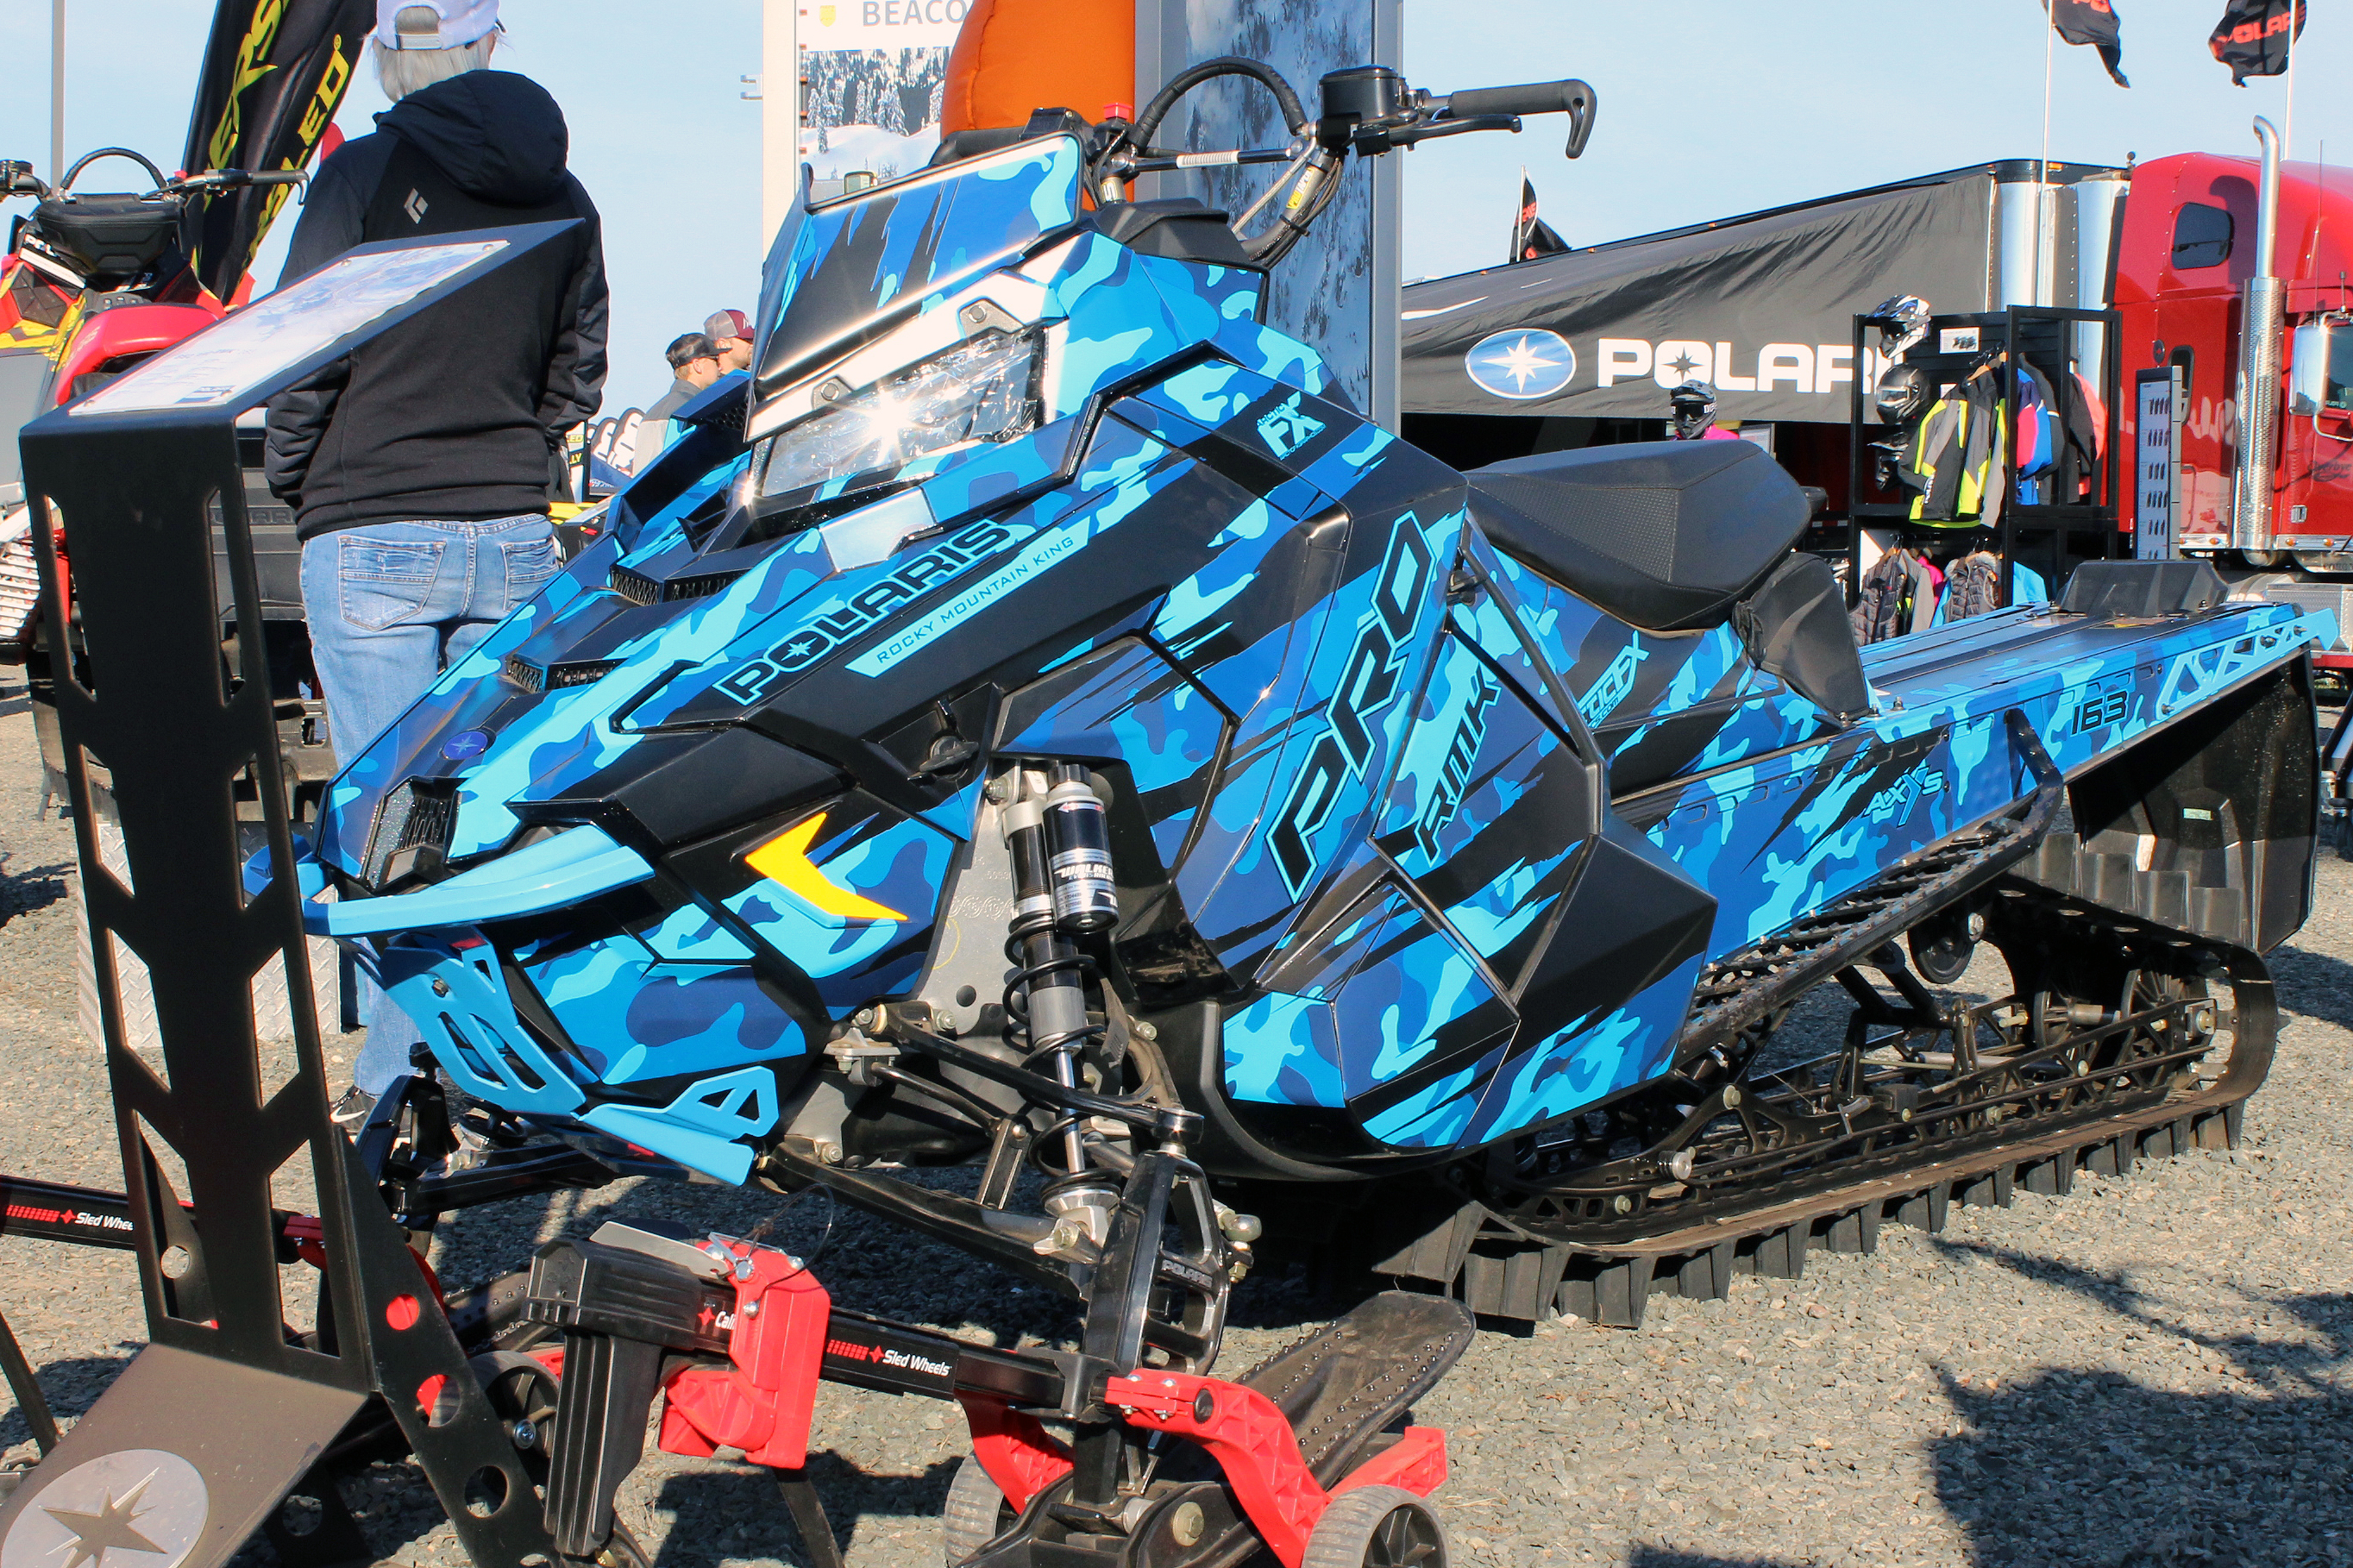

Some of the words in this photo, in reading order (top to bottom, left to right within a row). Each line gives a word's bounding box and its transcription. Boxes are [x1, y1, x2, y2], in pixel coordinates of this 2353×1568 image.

[863, 0, 968, 27] BEACO
[713, 519, 1013, 706] POLARIS
[876, 620, 936, 664] ROCKY
[941, 564, 1030, 624] MOUNTAIN
[1034, 536, 1076, 567] KING
[1265, 510, 1436, 904] PRO
[2070, 689, 2130, 735] 163
[1415, 663, 1502, 868] RMK
[1864, 765, 1944, 828] AXYS
[75, 1212, 104, 1227] Sled
[103, 1215, 135, 1232] Whee
[715, 1310, 735, 1330] Cali
[882, 1349, 910, 1368] Sled
[910, 1354, 951, 1377] Wheels
